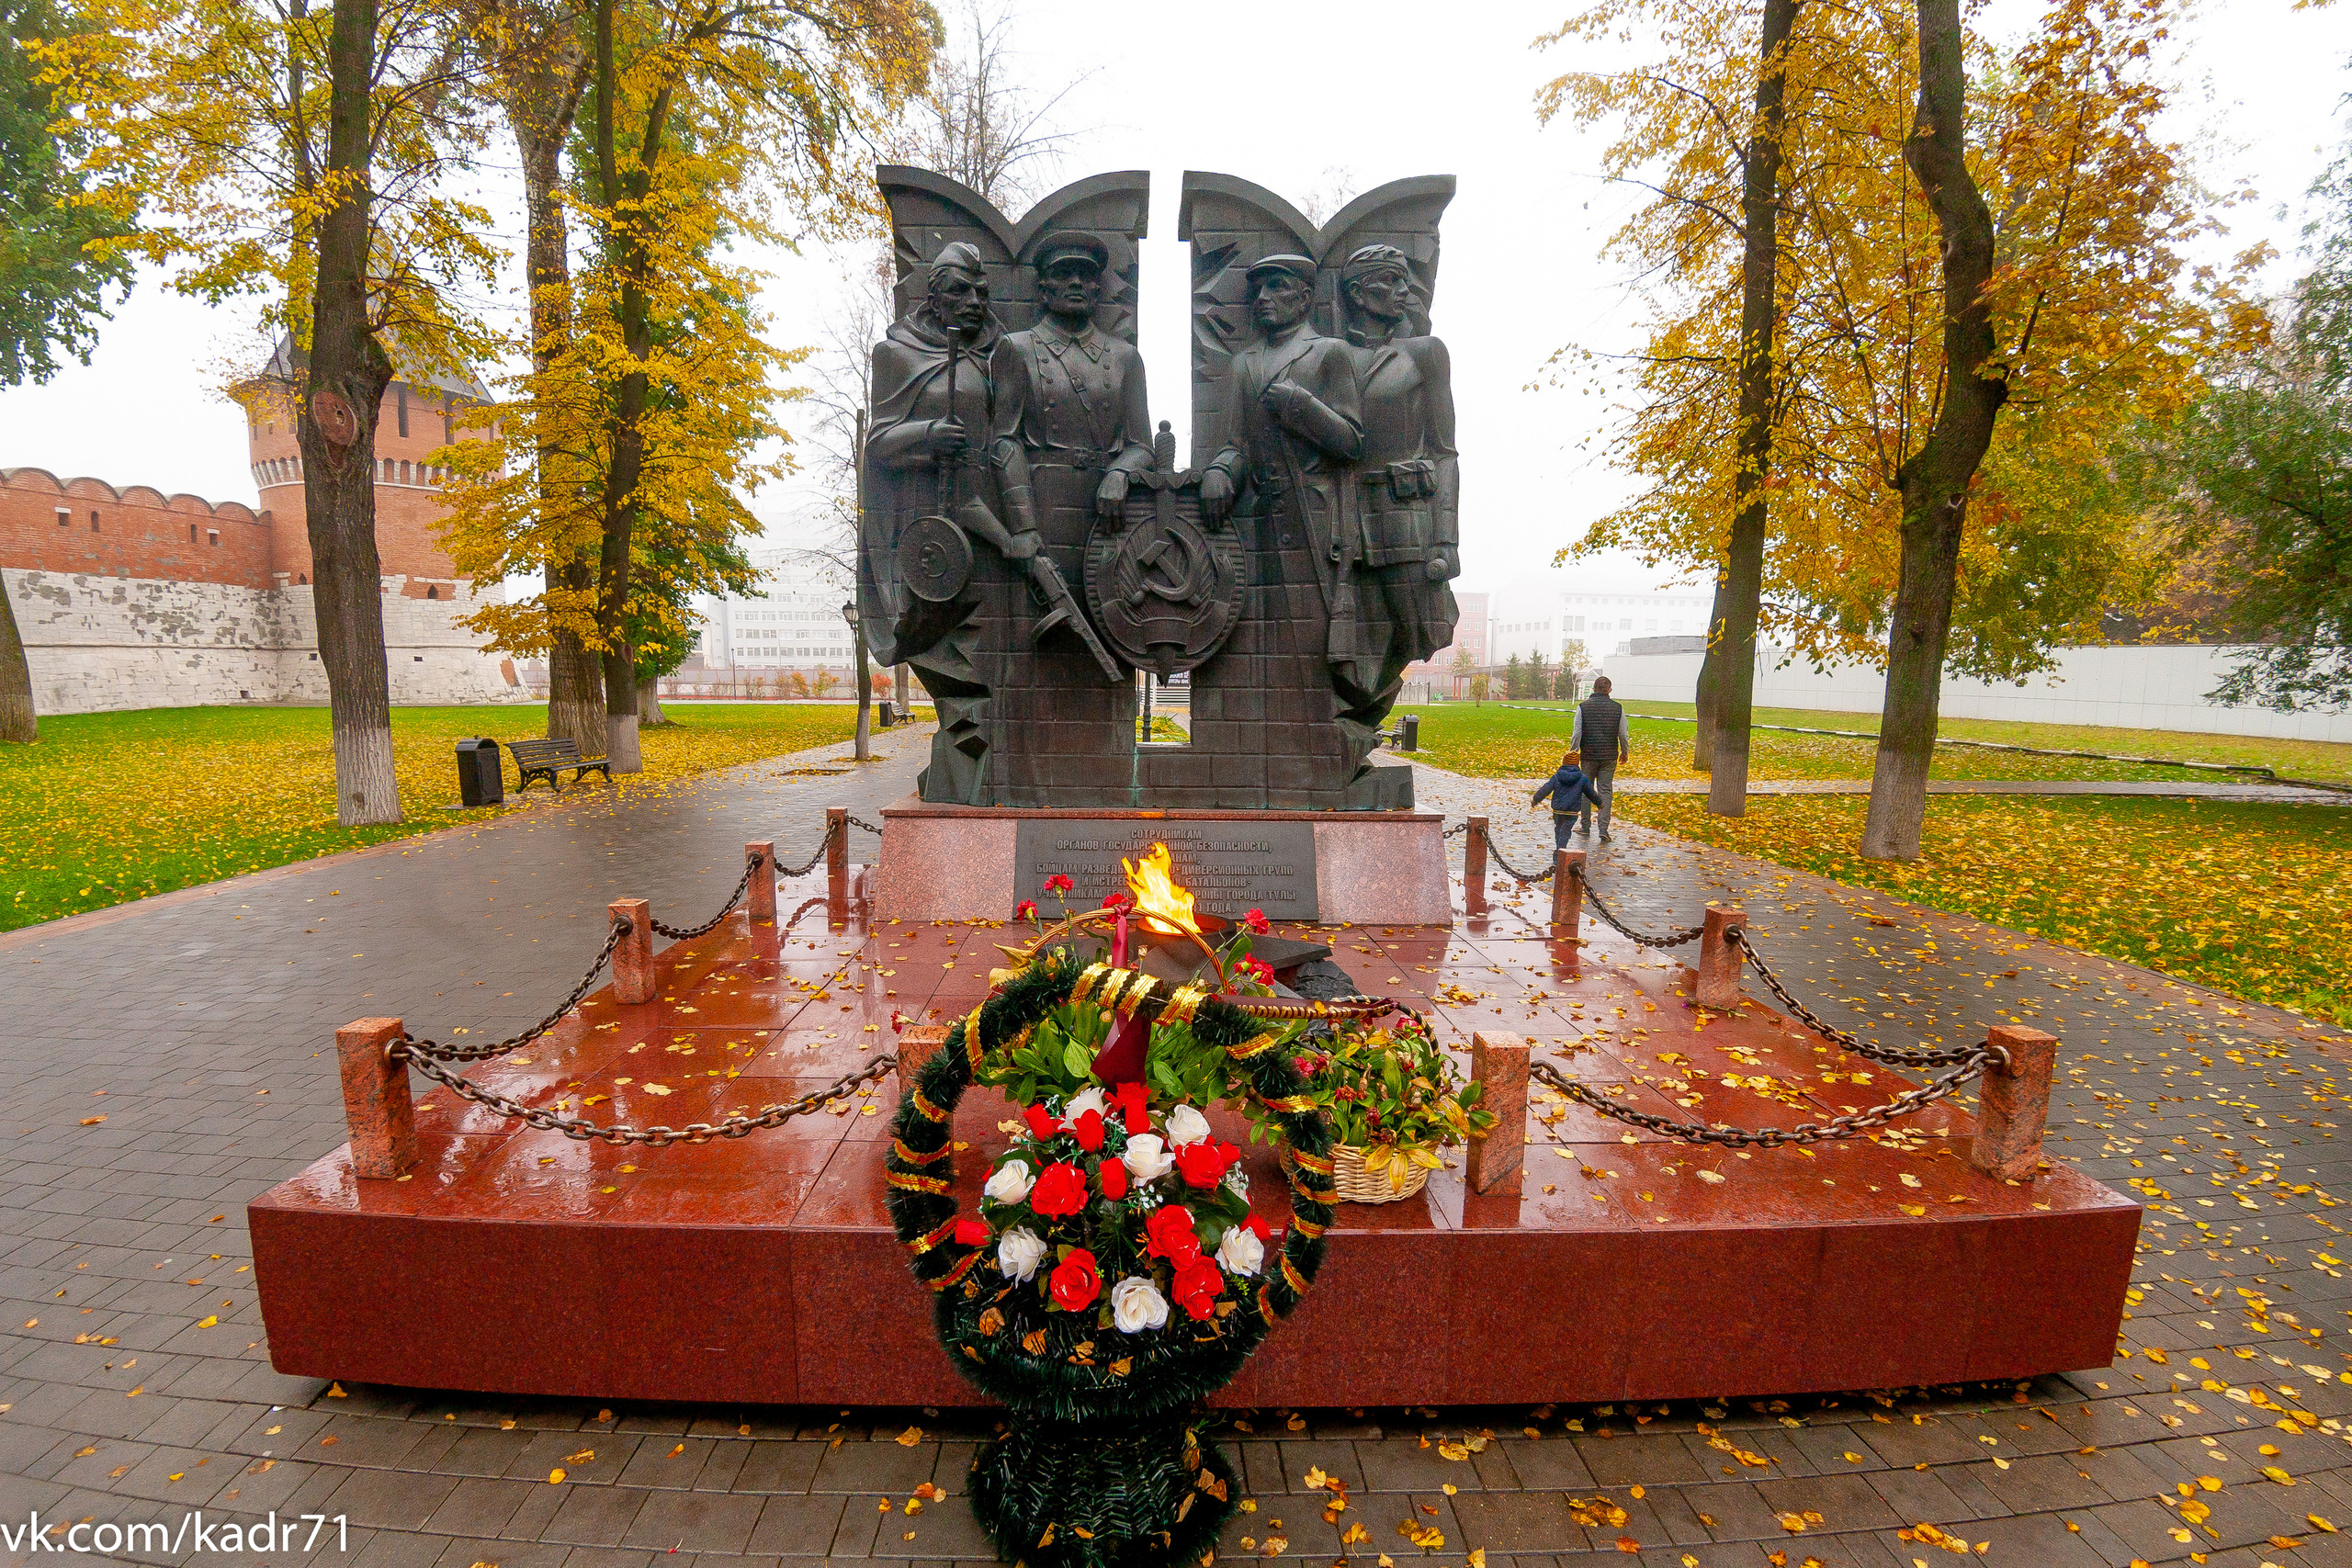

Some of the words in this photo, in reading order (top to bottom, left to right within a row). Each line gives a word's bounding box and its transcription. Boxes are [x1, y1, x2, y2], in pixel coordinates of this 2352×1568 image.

[1131, 829, 1202, 840] СОТРУДНИКАМ
[1057, 840, 1099, 851] ОРГАНОВ
[1196, 841, 1272, 853] БЕЗОПАСНОСТИ,
[1036, 862, 1078, 875] БОЙЦАМ
[1263, 865, 1293, 876] ГРУПП
[1082, 876, 1089, 886] И
[1036, 888, 1102, 898] УЧАТНИКАМ
[1227, 890, 1263, 903] ГОРОДА
[1268, 891, 1295, 902] ТУЛЫ
[1207, 902, 1235, 914] ГОДА.
